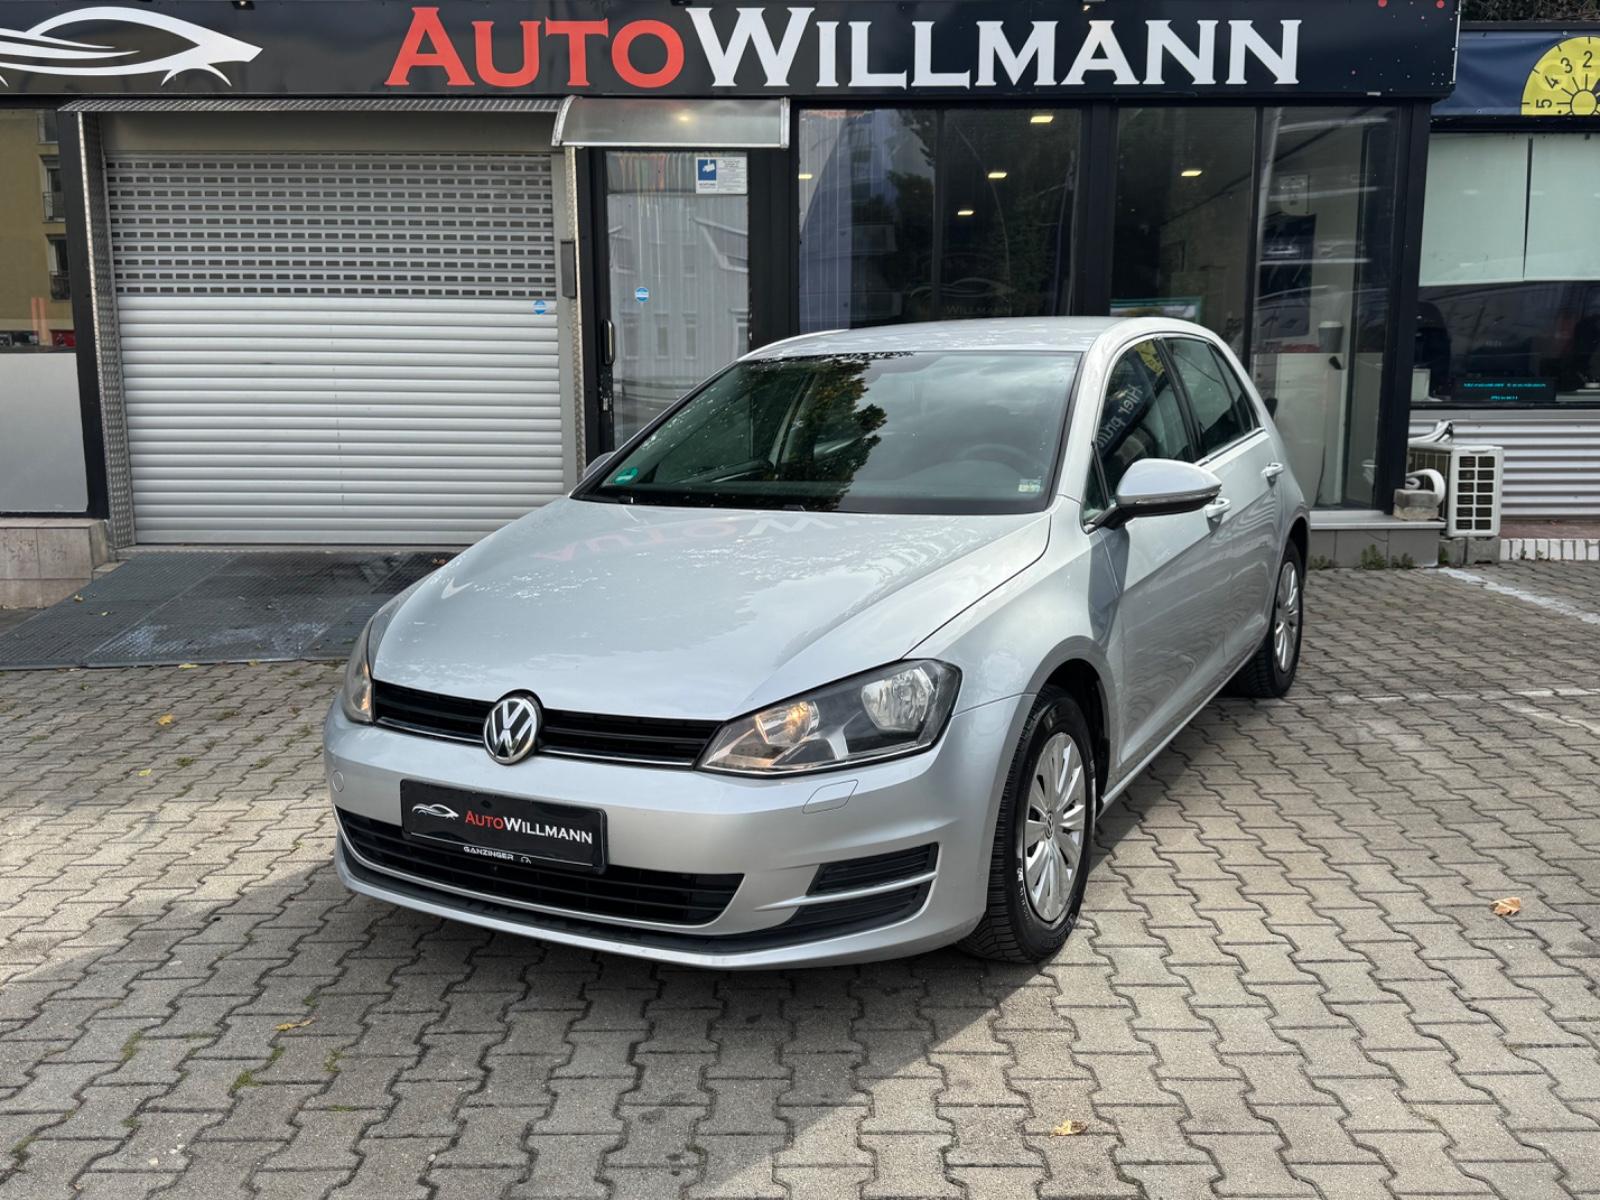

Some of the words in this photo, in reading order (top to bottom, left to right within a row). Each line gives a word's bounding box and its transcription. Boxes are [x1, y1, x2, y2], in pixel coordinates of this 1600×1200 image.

[1536, 99, 1552, 109] 5
[1545, 75, 1559, 88] 4
[1560, 57, 1573, 74] 3
[1582, 50, 1593, 68] 2
[464, 846, 514, 861] GANZINGER
